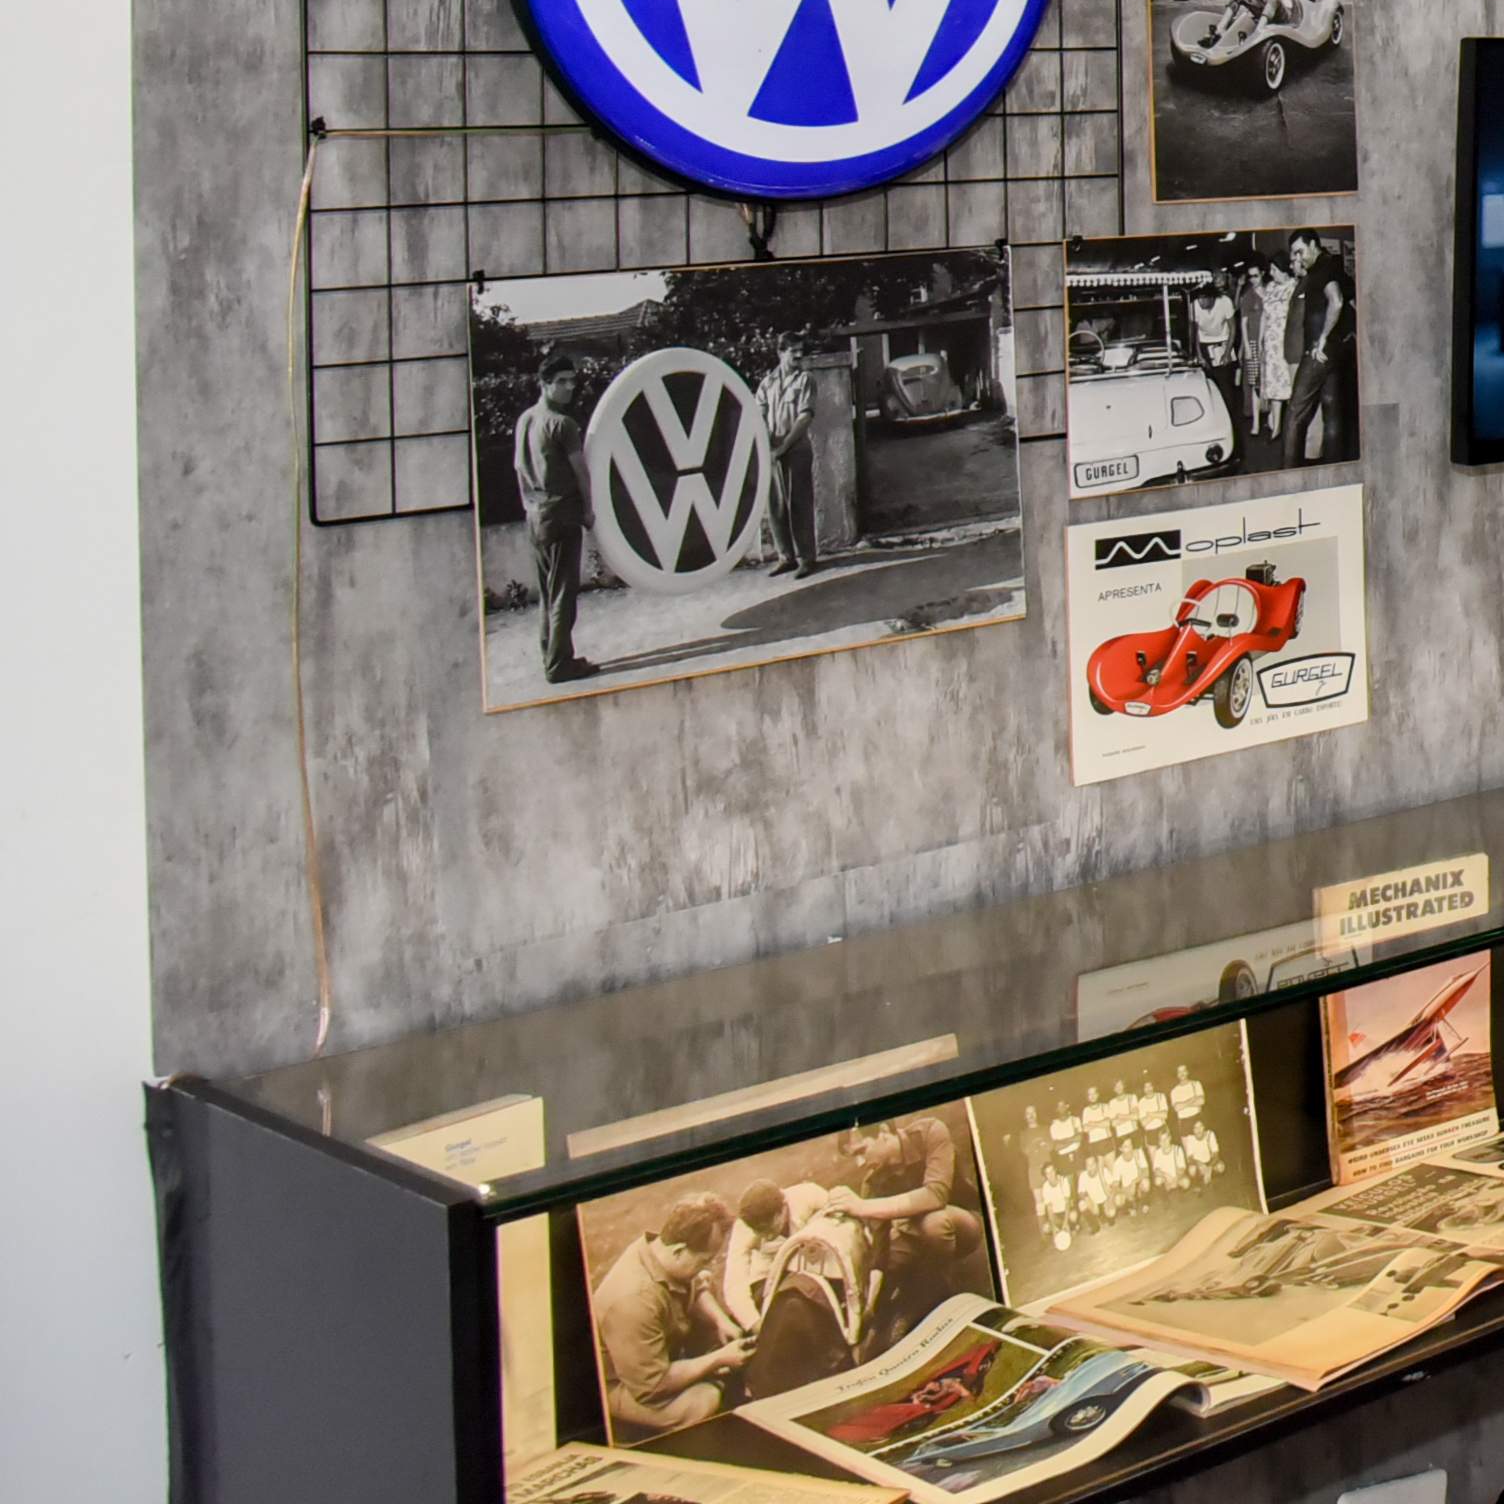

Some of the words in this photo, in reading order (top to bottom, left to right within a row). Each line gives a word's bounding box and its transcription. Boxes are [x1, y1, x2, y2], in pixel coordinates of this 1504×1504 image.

[1085, 462, 1128, 481] GURGEL
[1098, 583, 1162, 602] APRESENTA
[1271, 663, 1343, 688] GURGEL
[1348, 869, 1464, 911] MECHANIX
[1339, 891, 1475, 937] ILLUSTRATED
[1353, 1168, 1367, 1177] HOW
[1457, 1130, 1488, 1145] WORKSHOP
